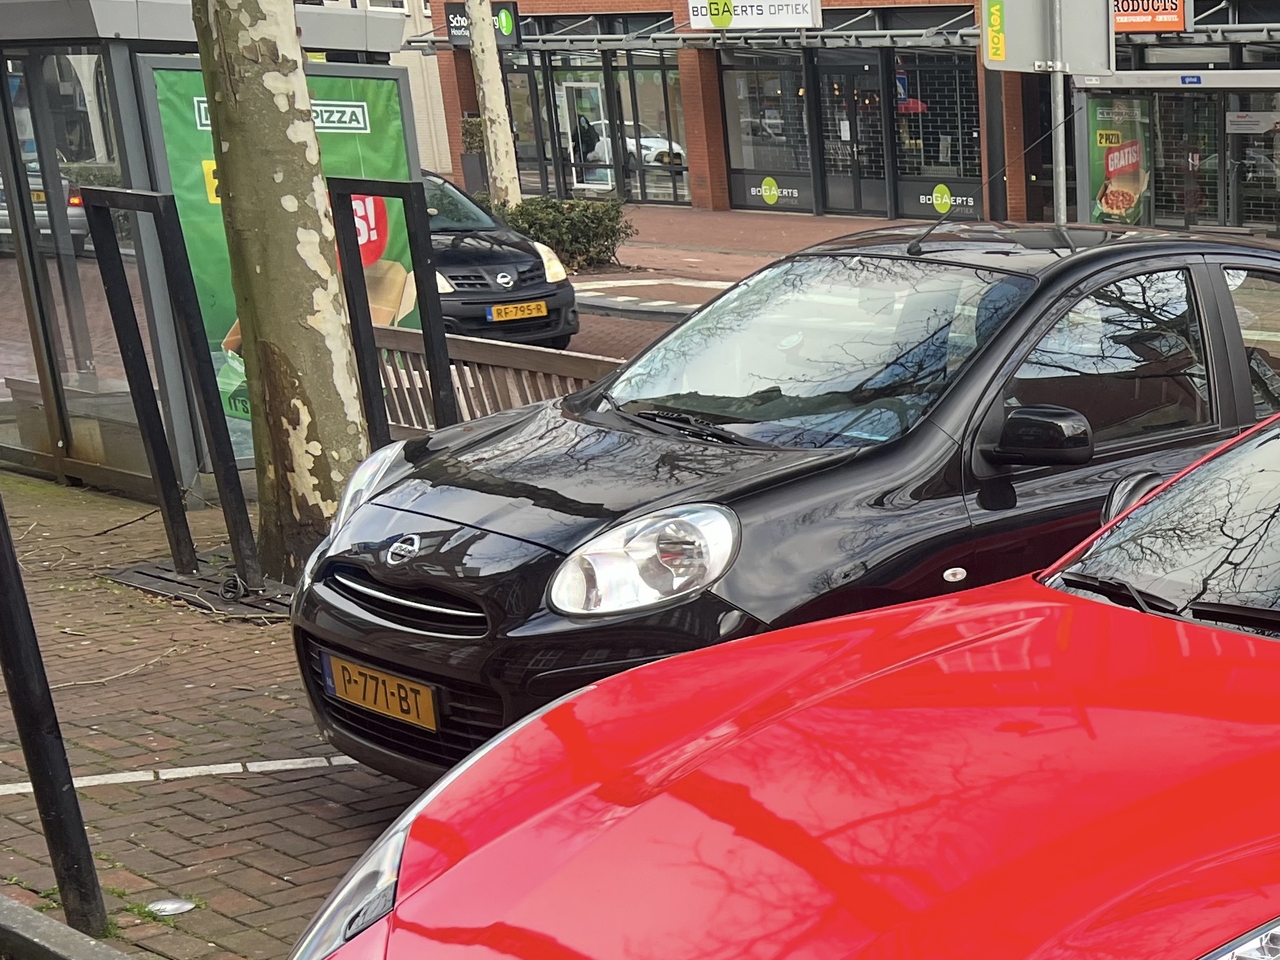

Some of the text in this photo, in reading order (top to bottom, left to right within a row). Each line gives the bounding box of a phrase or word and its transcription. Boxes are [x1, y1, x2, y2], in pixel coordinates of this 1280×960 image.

[768, 3, 809, 15] OPTIEK
[1105, 133, 1121, 145] PIZZA
[1108, 144, 1140, 172] GRATIS!
[340, 664, 422, 719] P-771-BT
